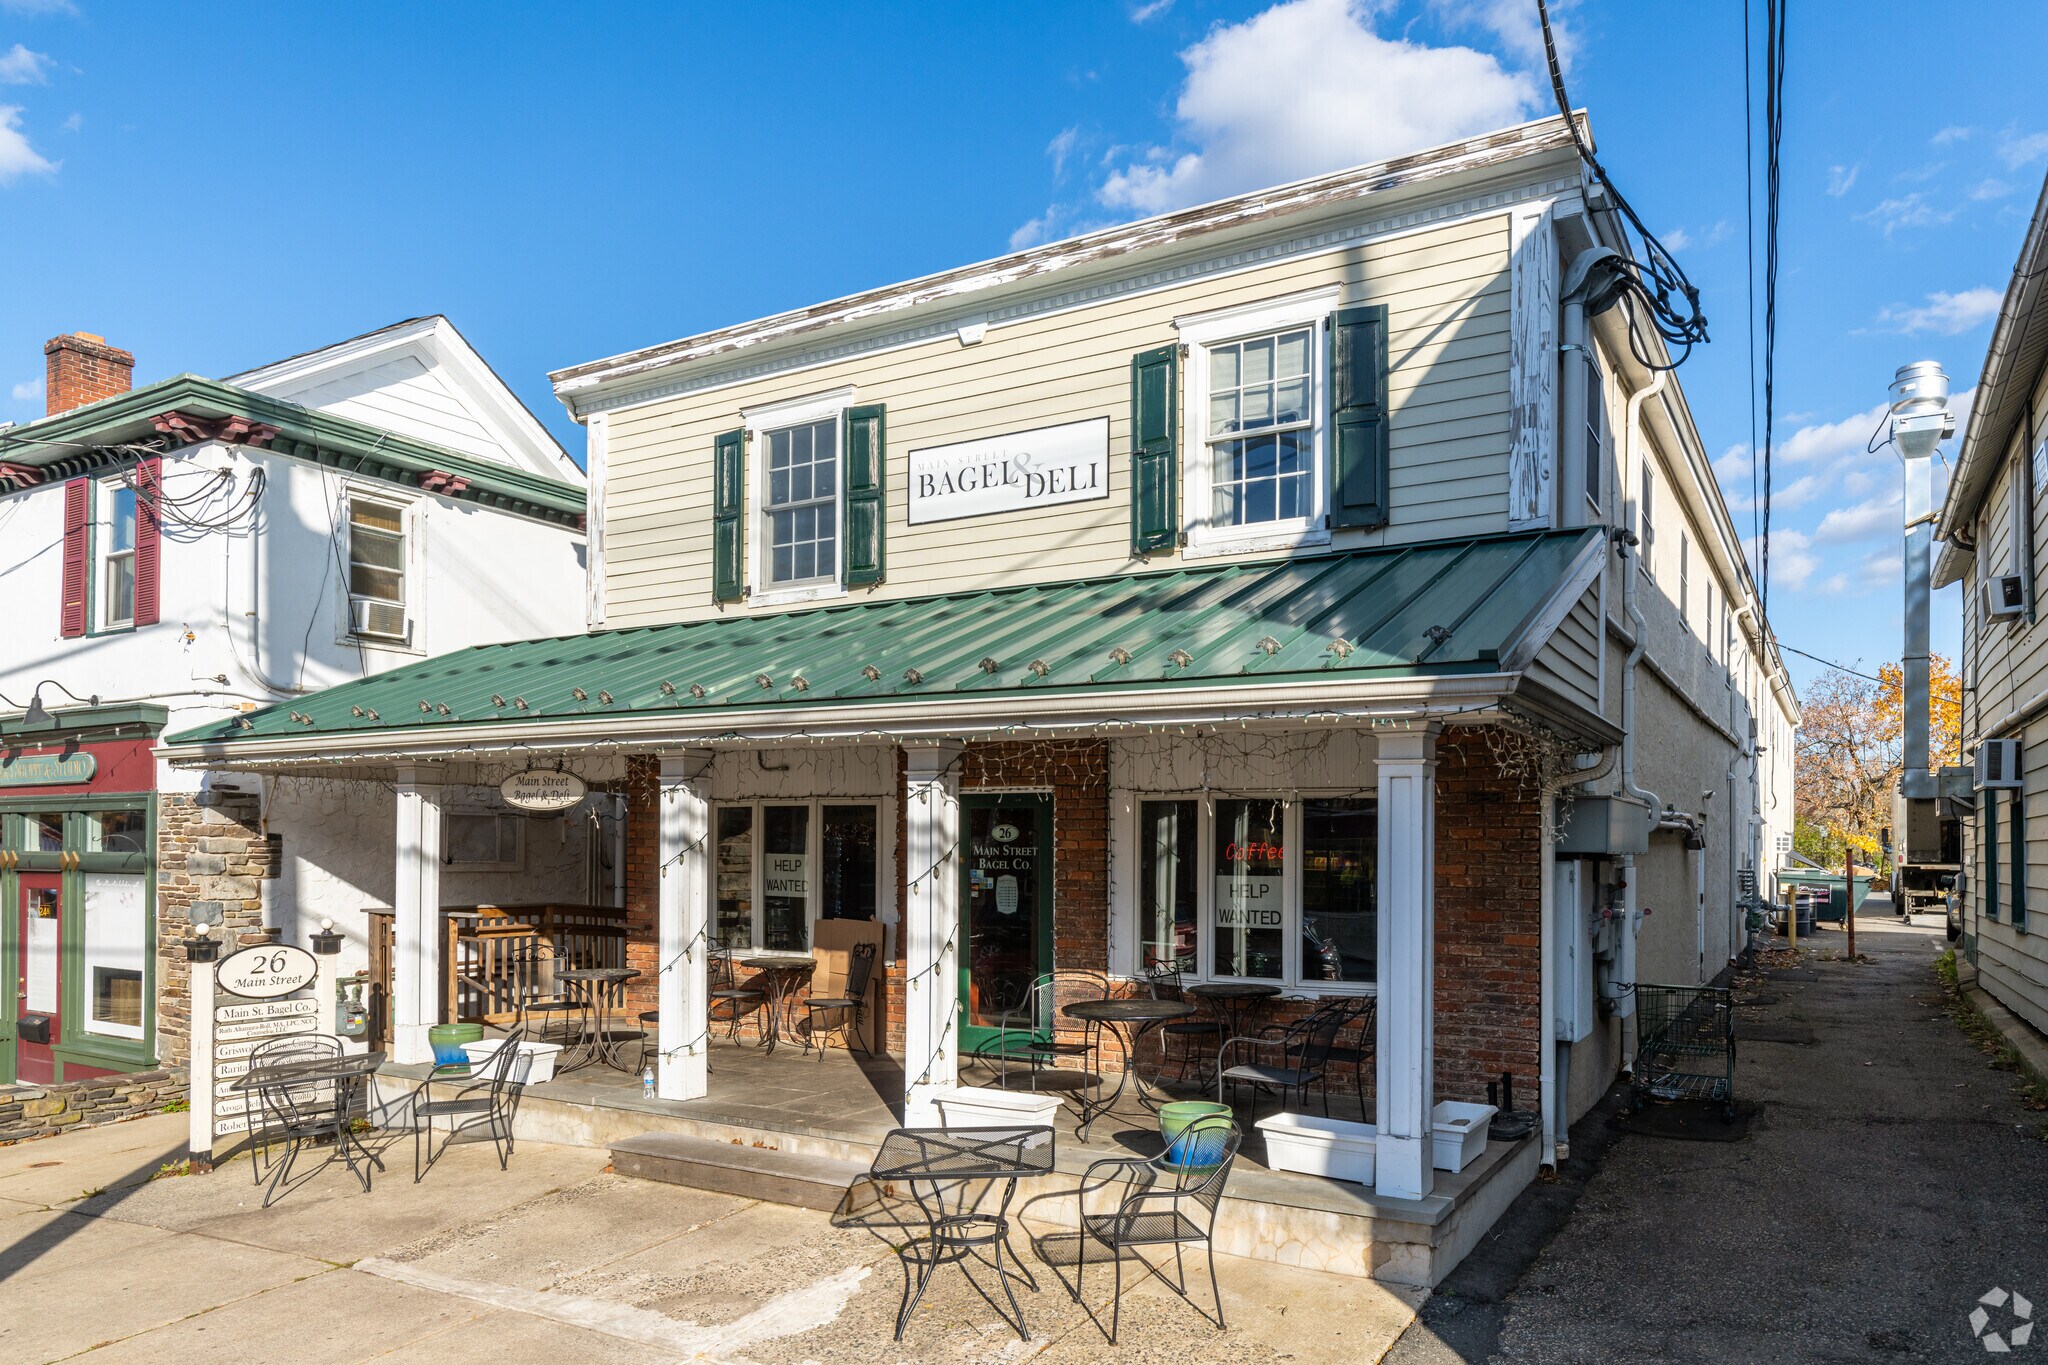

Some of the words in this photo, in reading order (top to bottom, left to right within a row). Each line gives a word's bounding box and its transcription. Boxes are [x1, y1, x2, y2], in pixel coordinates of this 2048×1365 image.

[917, 459, 949, 471] MAIN
[958, 449, 1008, 464] STREET
[1008, 452, 1045, 488] &
[918, 461, 1019, 499] BAGEL
[1024, 462, 1100, 499] DELI
[53, 760, 86, 777] STUDIO
[515, 776, 540, 787] Main
[542, 775, 569, 787] Street
[514, 789, 540, 804] Bagel
[541, 790, 548, 802] &
[550, 789, 570, 801] Deli
[999, 827, 1012, 839] 26
[1225, 841, 1284, 861] Coffee
[774, 859, 802, 872] HELP
[766, 878, 809, 893] WANTED
[1229, 883, 1270, 899] HELP
[1218, 908, 1282, 925] WANTED
[250, 950, 288, 975] 26
[233, 977, 267, 989] Main
[269, 974, 303, 986] Street
[223, 1006, 250, 1019] Main
[251, 1006, 264, 1017] St.
[267, 1003, 293, 1015] Bagel
[295, 1002, 311, 1012] Co.
[219, 1104, 243, 1113] Aroga
[220, 1119, 248, 1132] Rober
